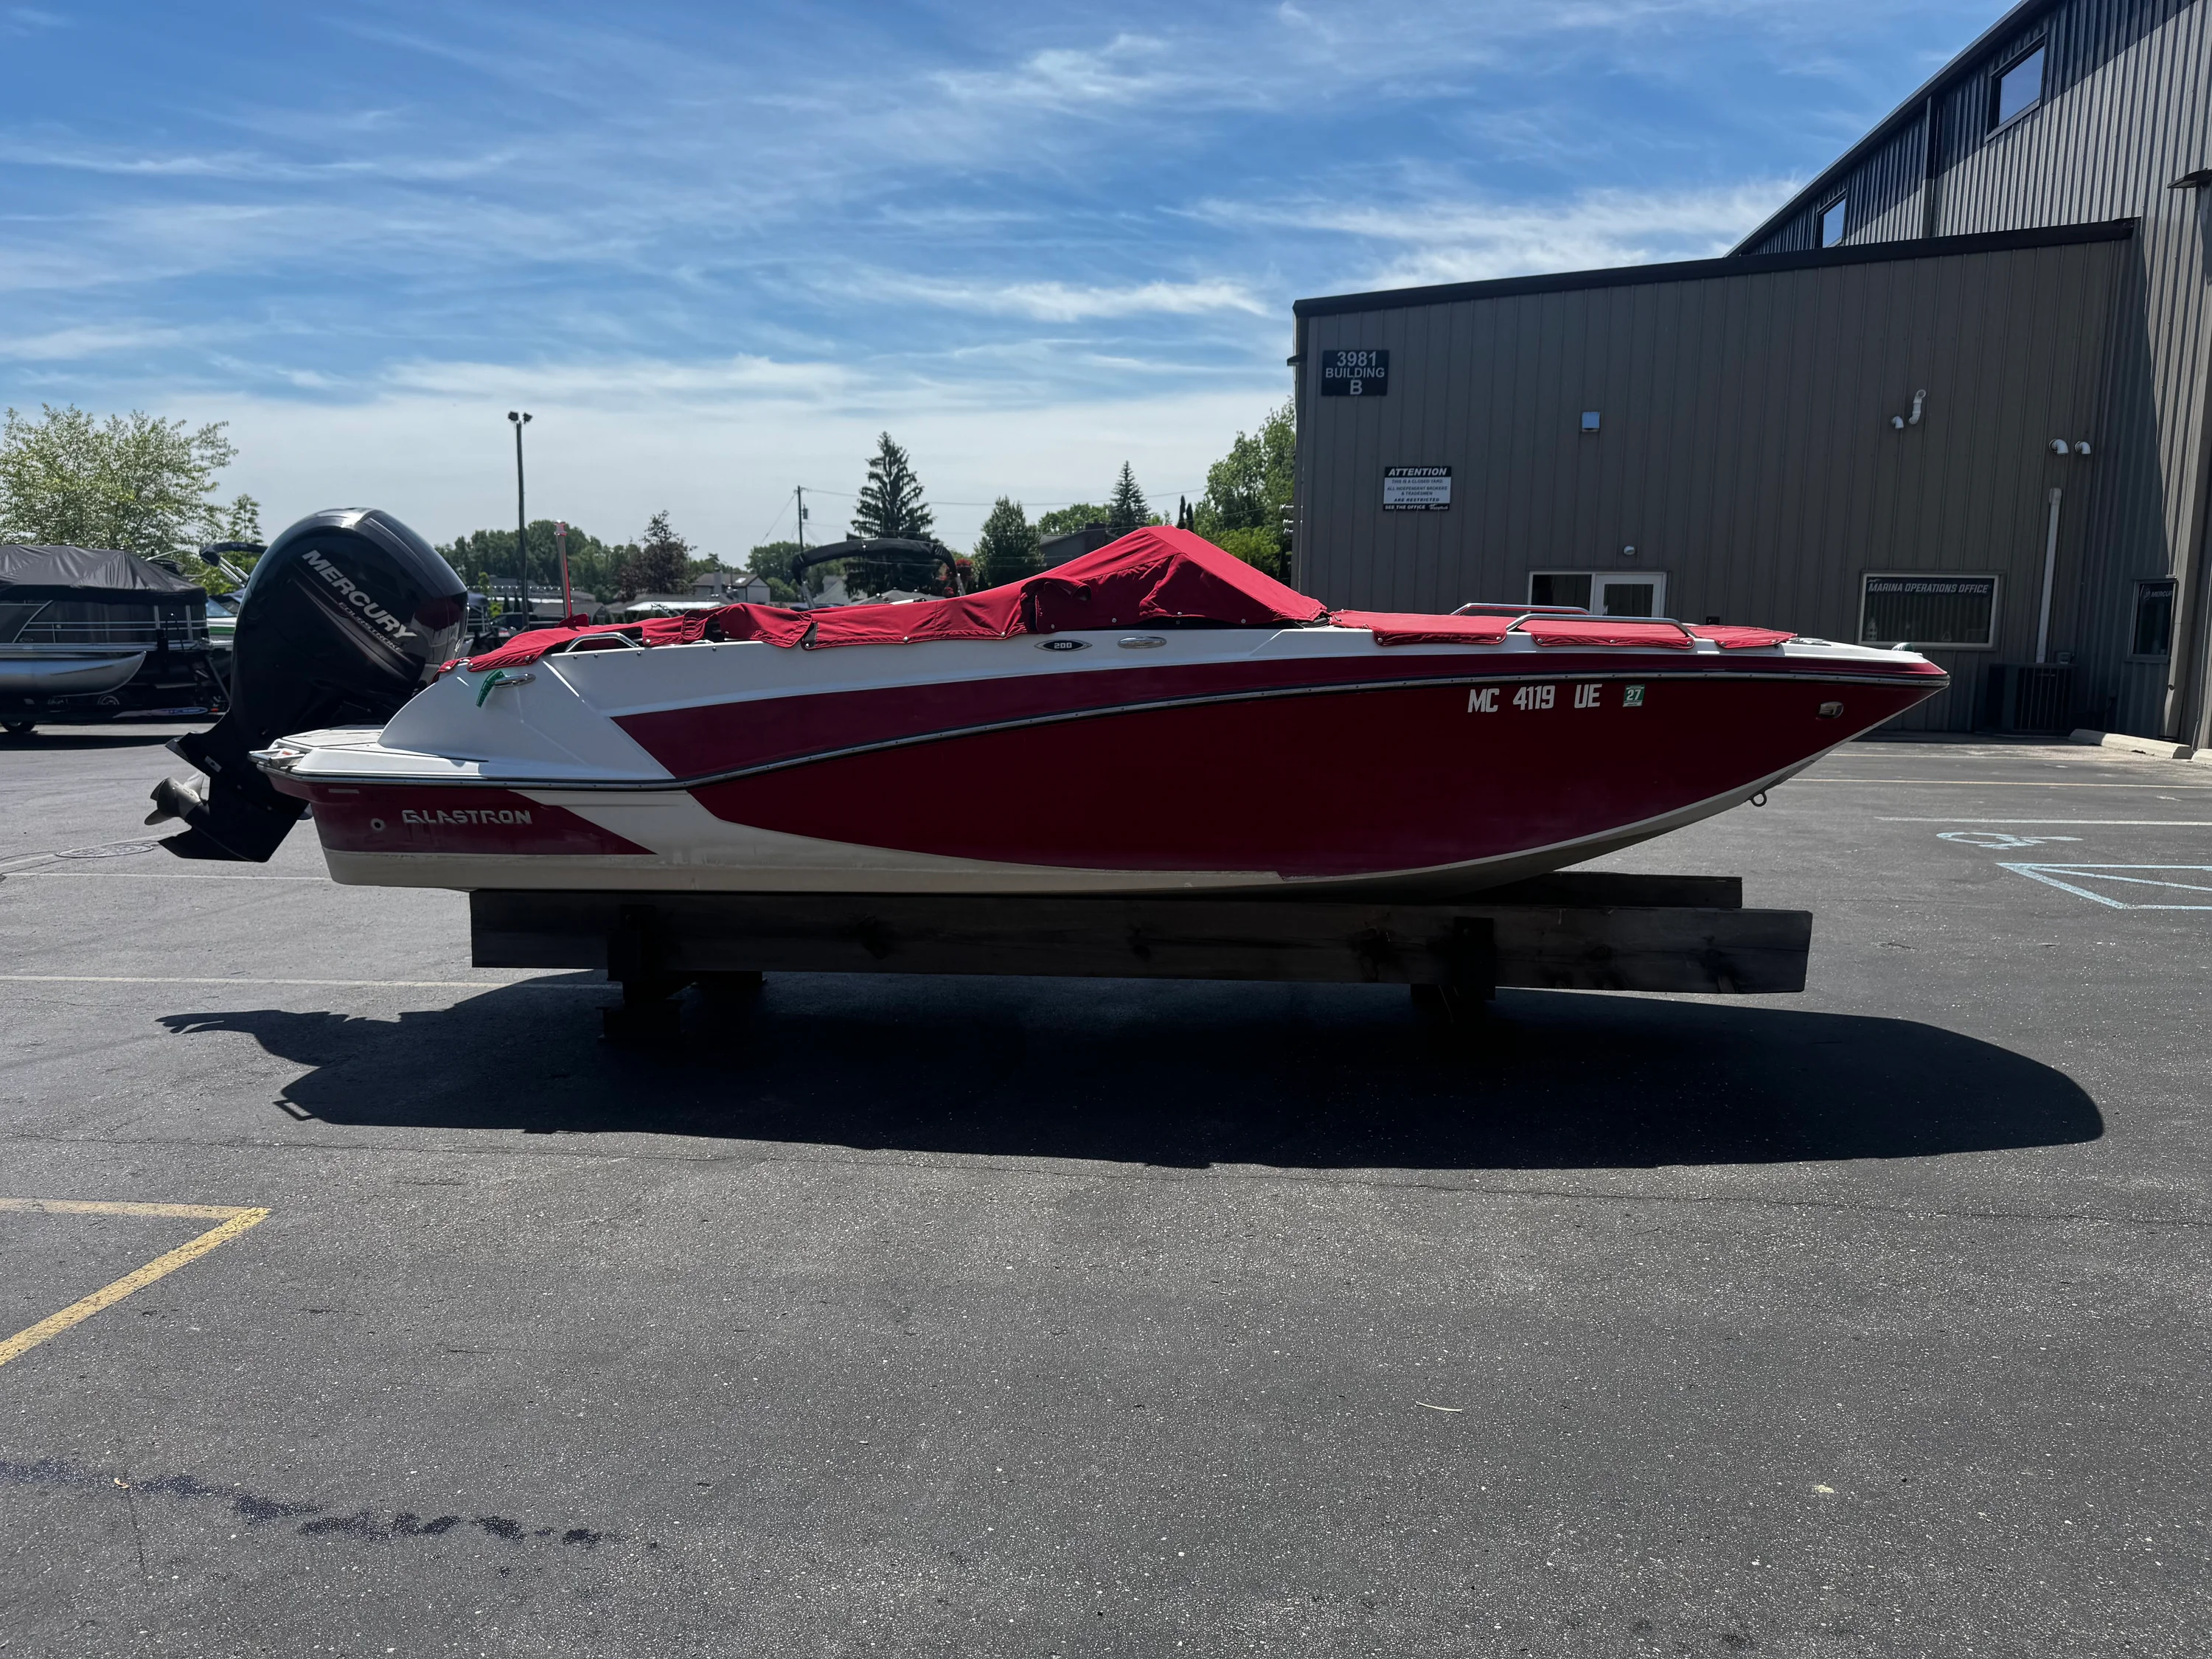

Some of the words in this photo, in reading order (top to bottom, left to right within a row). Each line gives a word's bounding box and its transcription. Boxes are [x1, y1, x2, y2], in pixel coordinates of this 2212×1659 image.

[1337, 351, 1376, 366] 3981
[1326, 367, 1385, 378] BUILDING
[1350, 380, 1363, 394] B
[1388, 467, 1447, 476] ATTENTION
[302, 550, 417, 639] MERCURY
[1868, 582, 1903, 592] MARINA
[1905, 582, 1958, 593] OPERATIONS
[1958, 584, 1989, 594] OFFICE
[338, 602, 404, 653] FOURSTROKE
[1467, 688, 1500, 713] MC
[1512, 685, 1556, 711] 4119
[1574, 684, 1603, 709] UE
[1626, 689, 1641, 700] 27
[402, 810, 532, 824] GLASTRON
